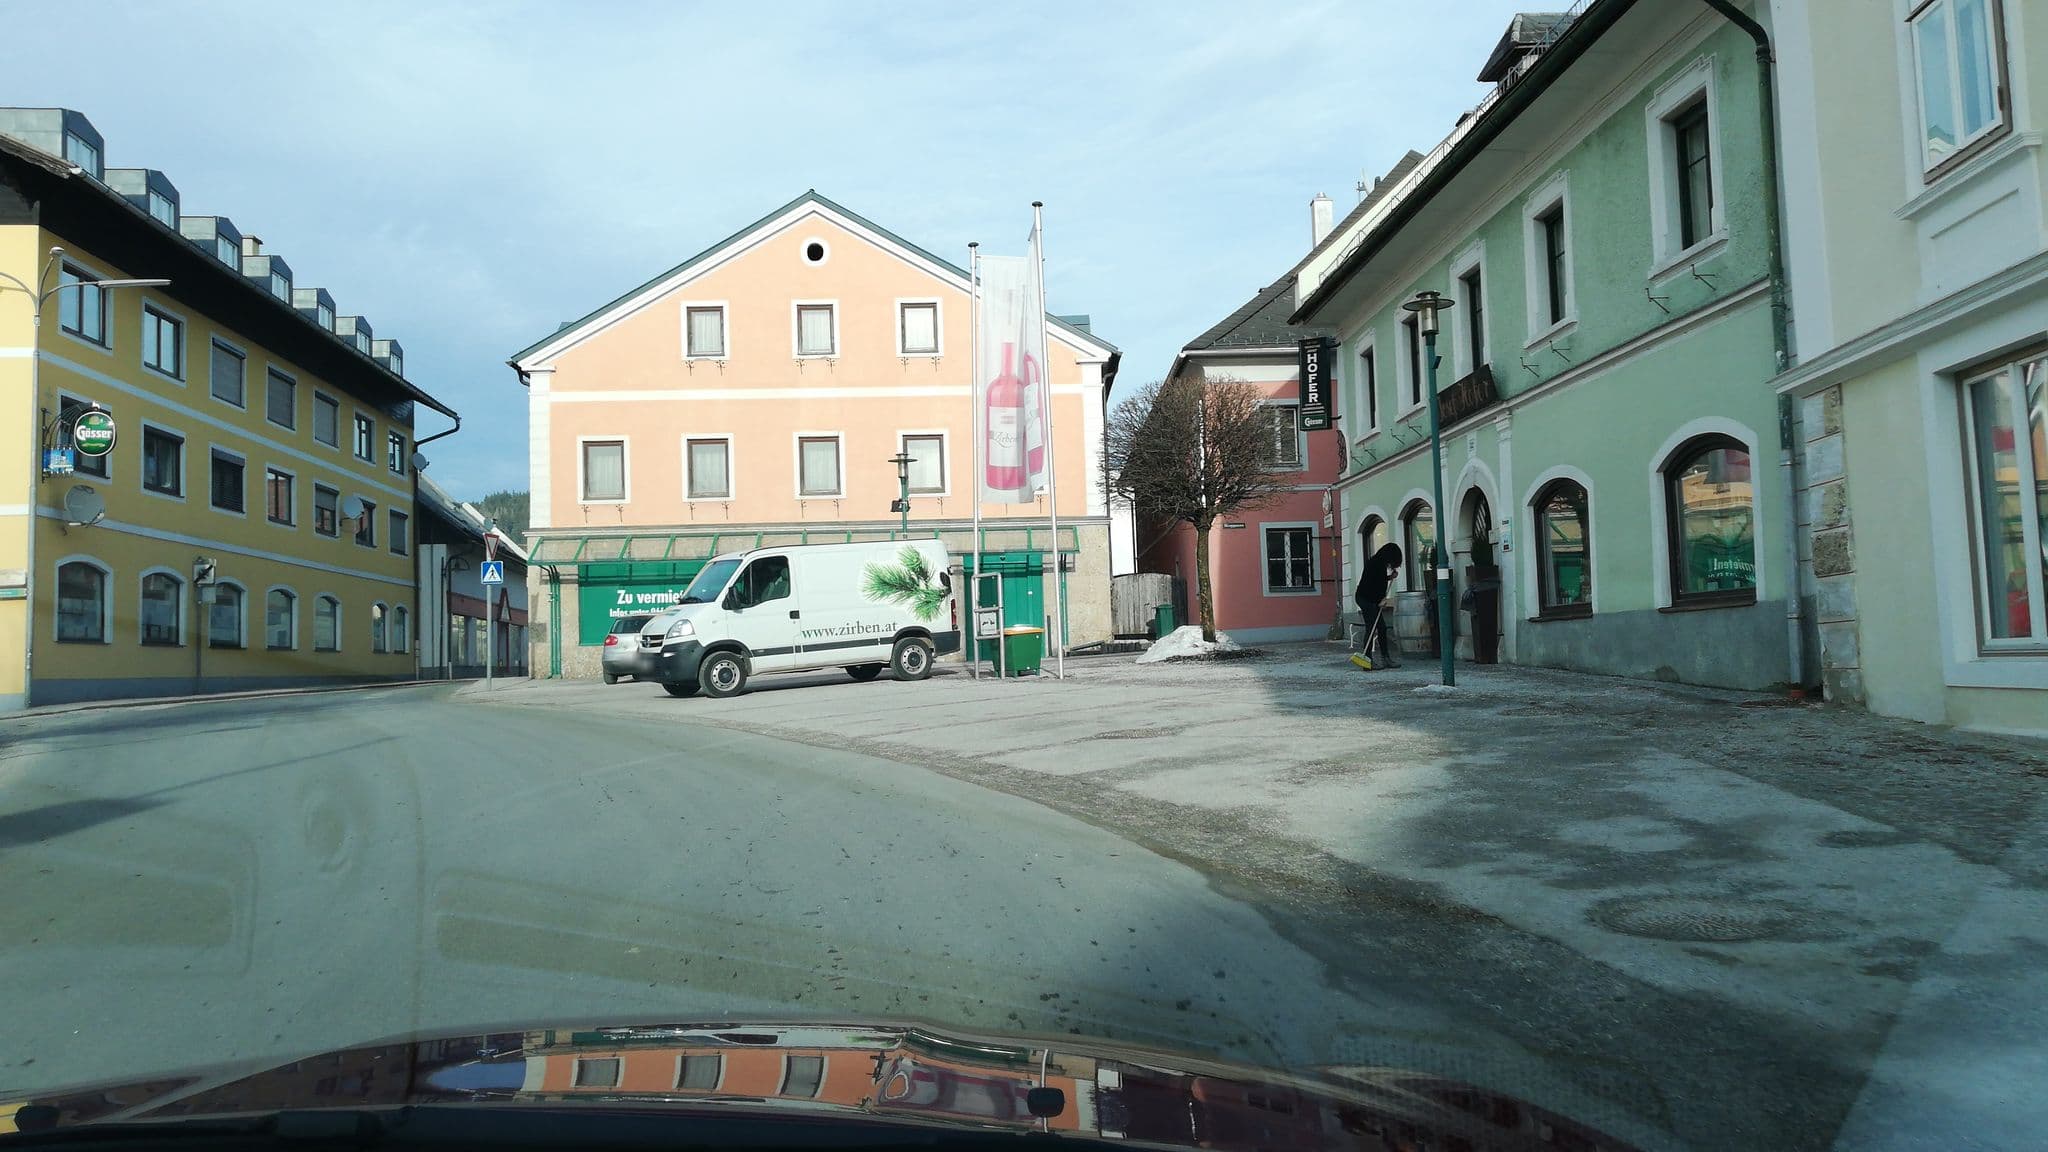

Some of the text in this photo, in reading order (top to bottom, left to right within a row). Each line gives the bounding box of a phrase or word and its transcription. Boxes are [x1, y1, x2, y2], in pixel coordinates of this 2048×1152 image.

[1306, 353, 1319, 403] HOFER
[76, 425, 113, 440] Gösser
[617, 589, 633, 605] Zu
[801, 621, 898, 639] www.zirben.at
